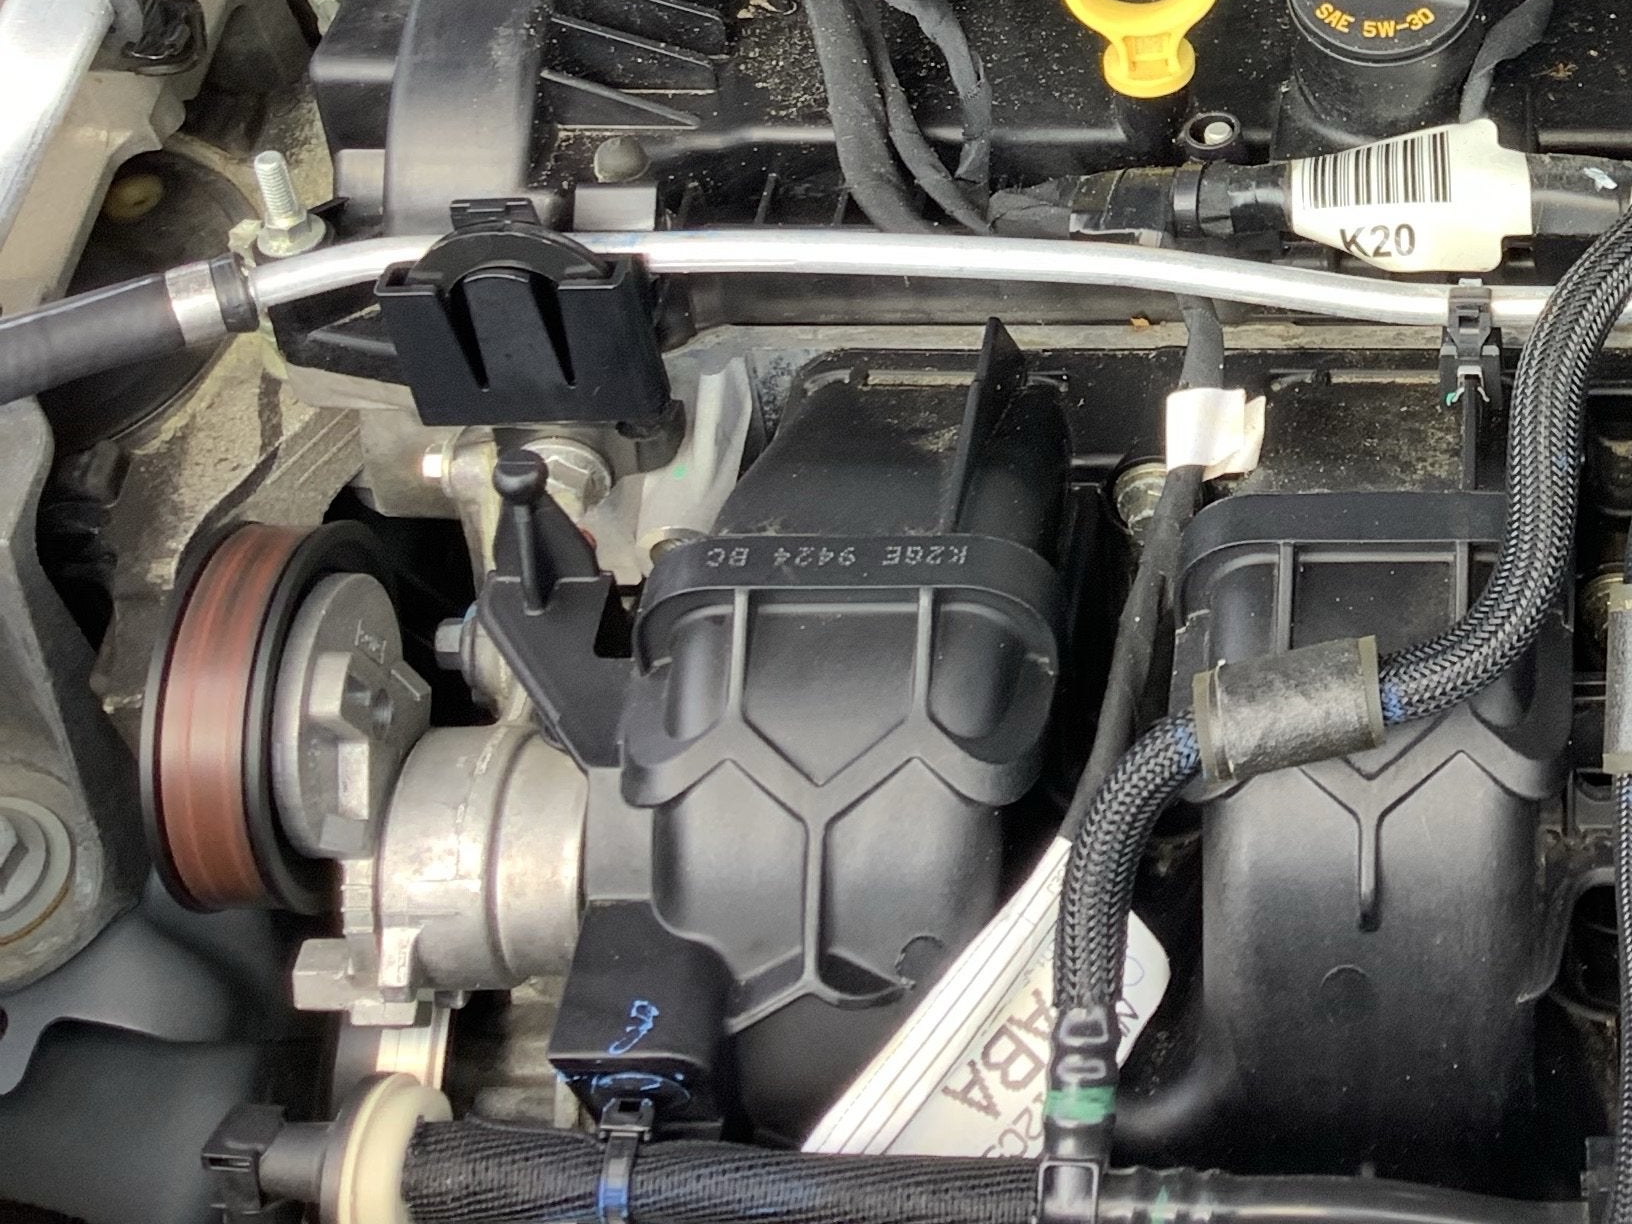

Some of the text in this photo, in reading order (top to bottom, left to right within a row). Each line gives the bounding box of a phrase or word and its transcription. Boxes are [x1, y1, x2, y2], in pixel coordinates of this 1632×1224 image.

[1314, 3, 1435, 38] SAE 5W-30
[1340, 223, 1415, 257] K20
[705, 545, 968, 567] K2GE 9424 BC
